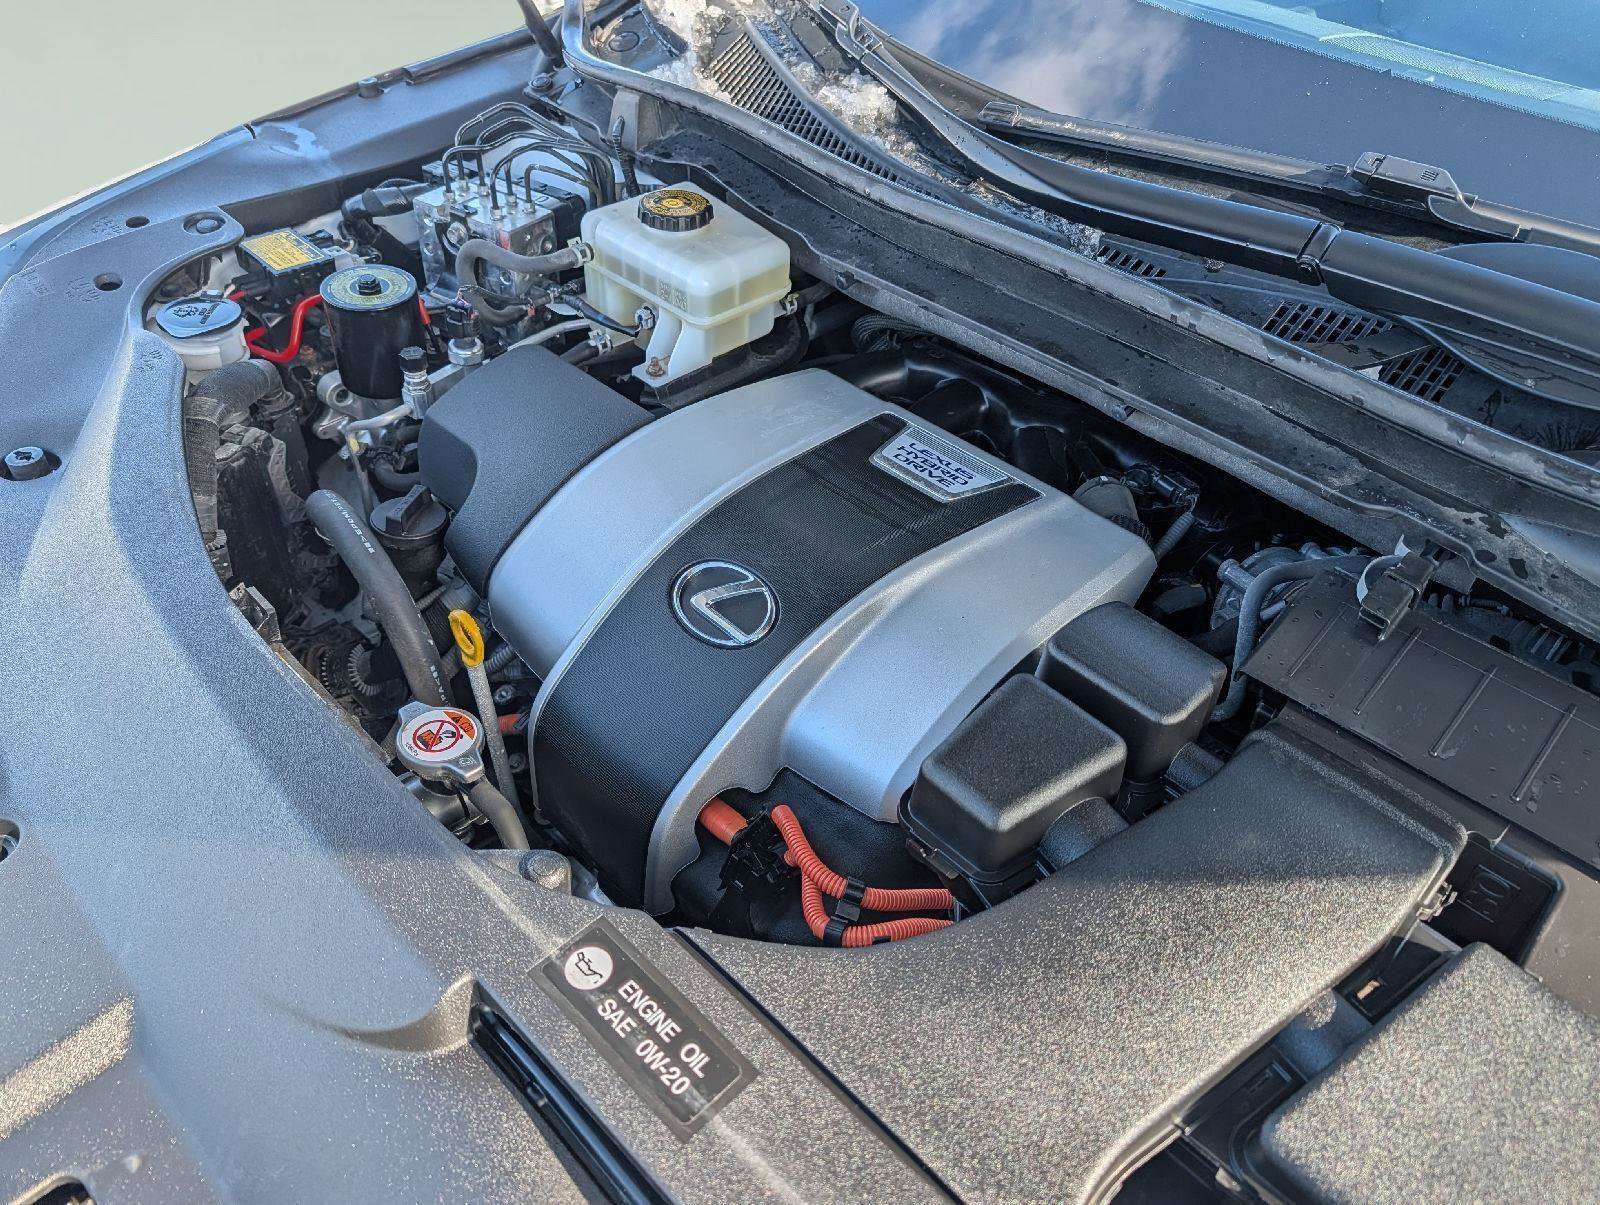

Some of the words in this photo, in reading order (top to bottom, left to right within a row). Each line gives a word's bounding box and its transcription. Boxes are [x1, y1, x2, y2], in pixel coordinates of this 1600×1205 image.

[892, 453, 956, 488] DRIVE
[896, 445, 969, 486] HYBRID
[908, 442, 974, 480] LEXUS
[597, 998, 638, 1039] SAE
[635, 1039, 691, 1095] 0W-20
[617, 979, 683, 1044] ENGINE
[680, 1042, 711, 1079] OIL
